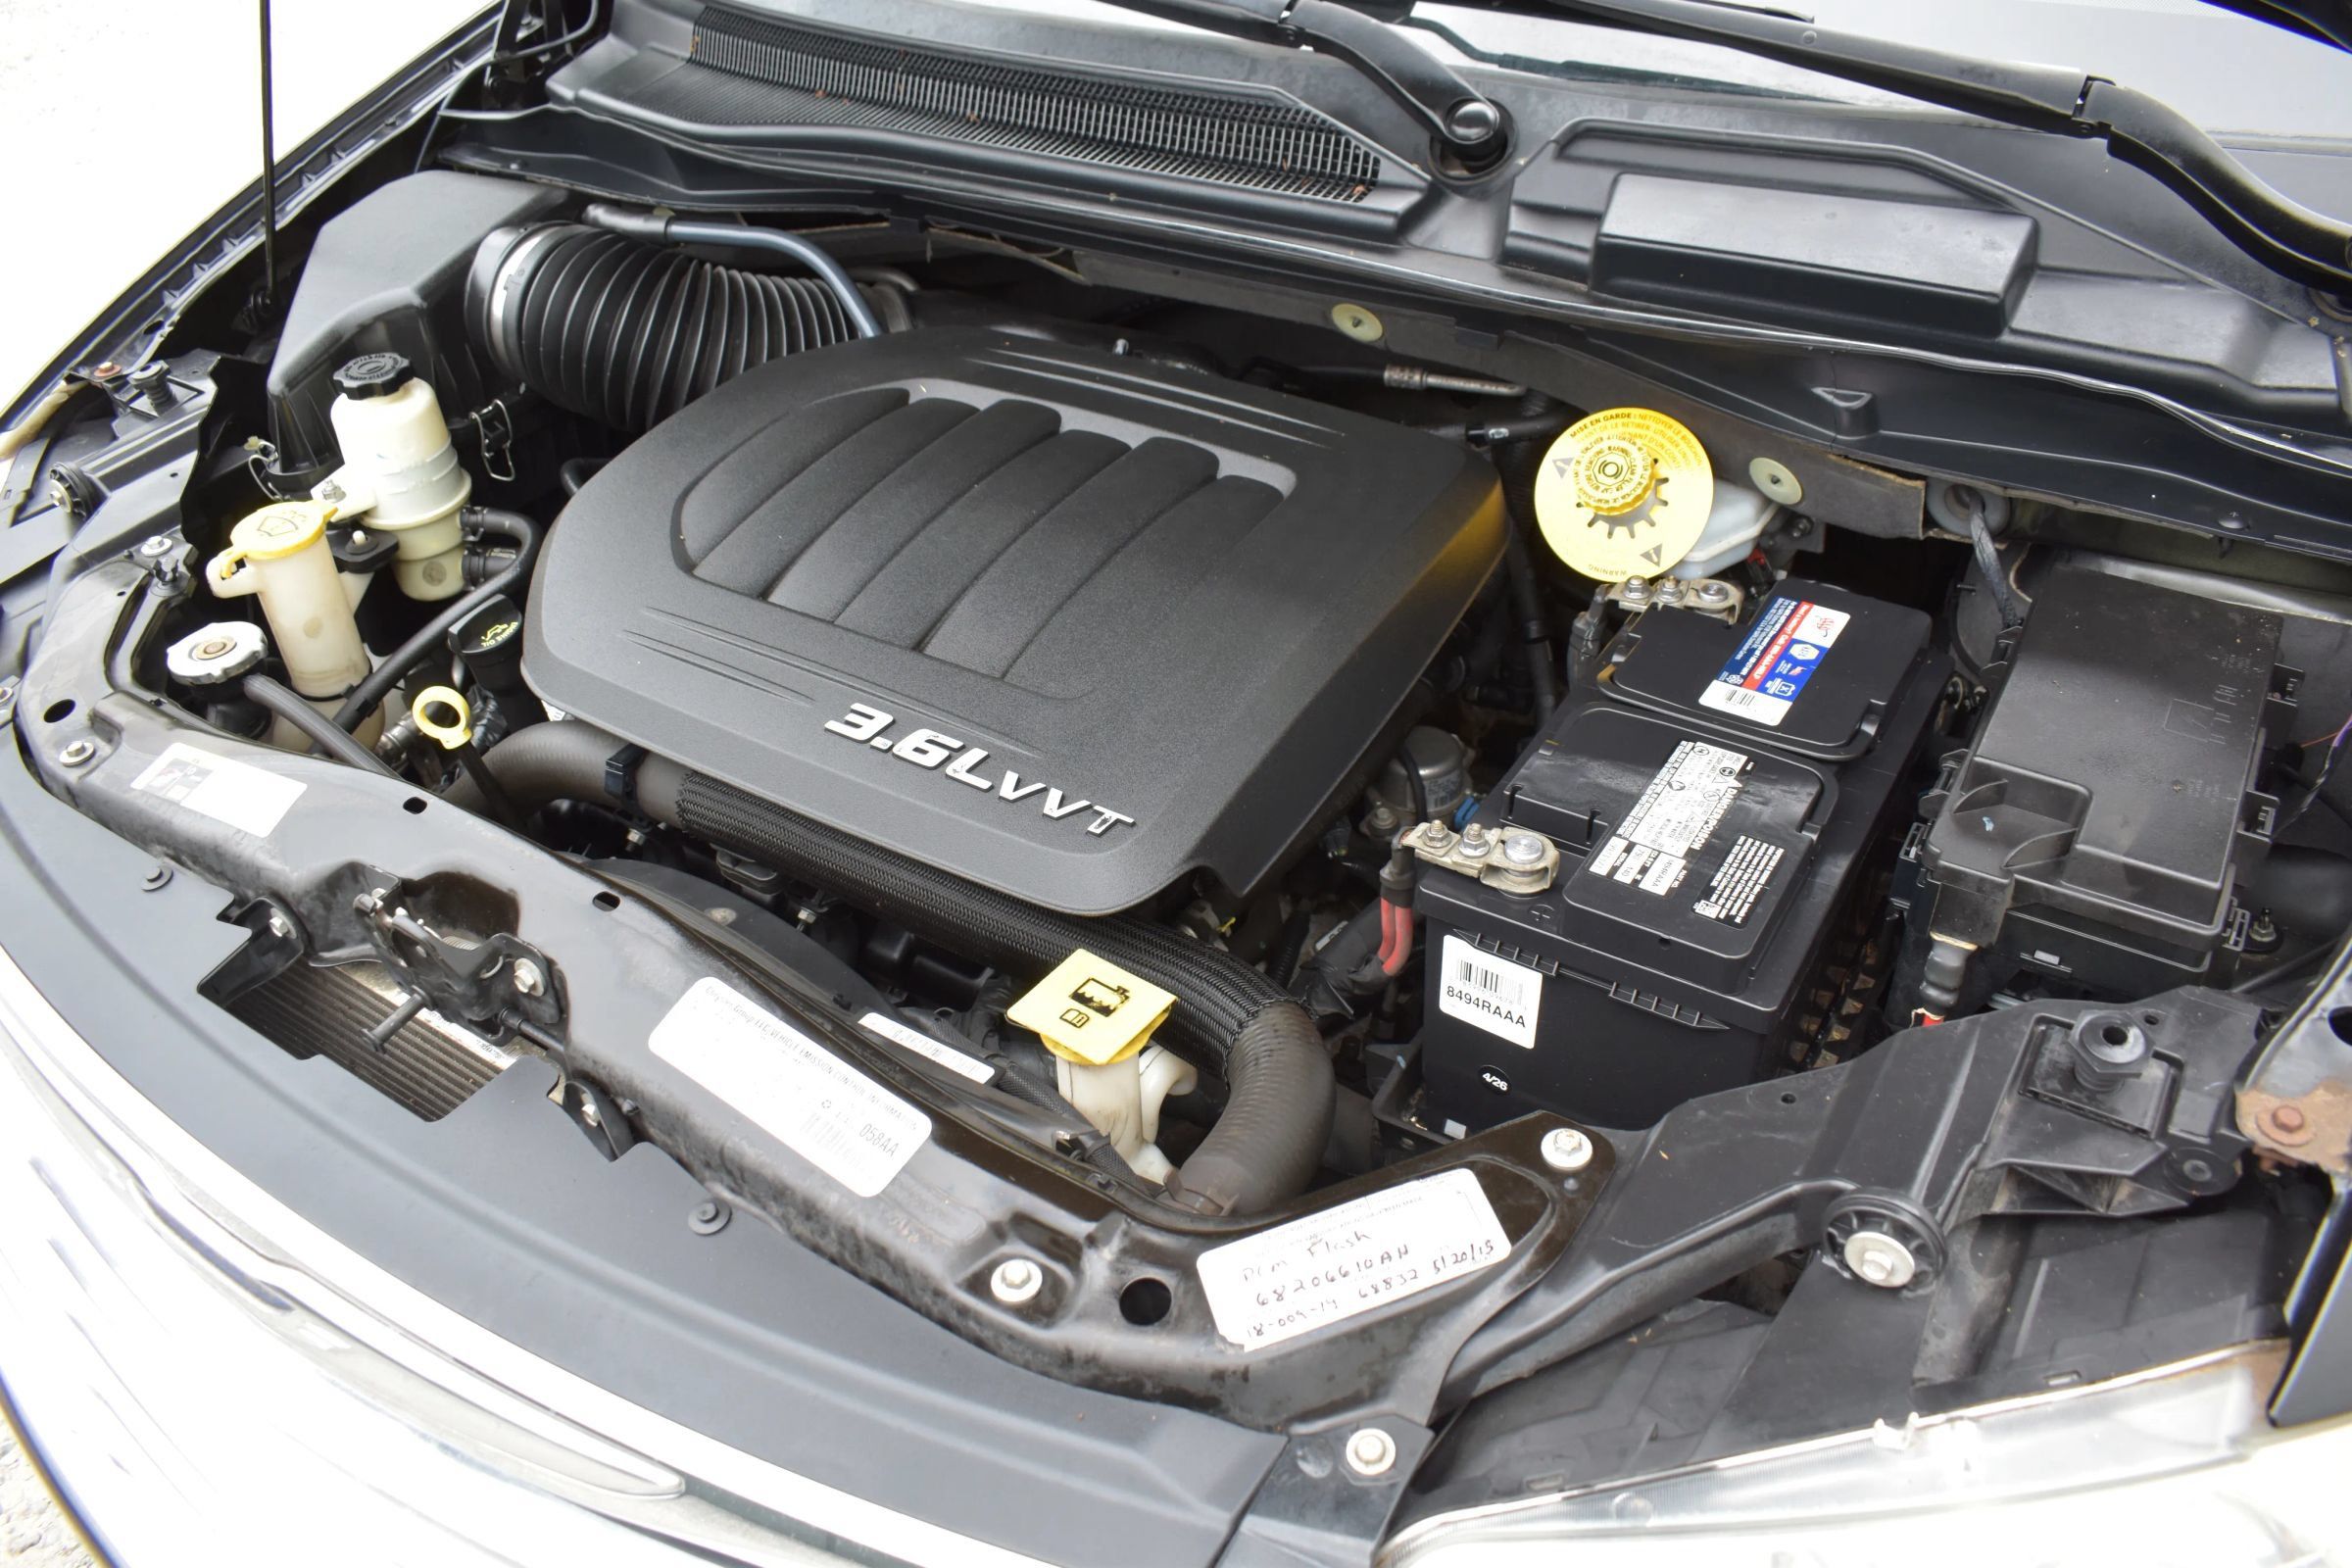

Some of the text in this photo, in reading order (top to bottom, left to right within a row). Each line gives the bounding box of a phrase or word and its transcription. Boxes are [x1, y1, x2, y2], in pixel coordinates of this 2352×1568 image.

[1570, 421, 1590, 437] MISE
[1590, 416, 1601, 426] EN
[1588, 564, 1627, 576] WARNING
[1690, 787, 1738, 851] DANGER/POISON
[1446, 985, 1526, 1028] 8494RAAA
[733, 1004, 754, 1024] Group
[770, 1026, 799, 1052] VEHICLE
[800, 1048, 834, 1075] EMISSION
[1483, 1072, 1508, 1092] 4/26
[1307, 1230, 1372, 1257] Flash
